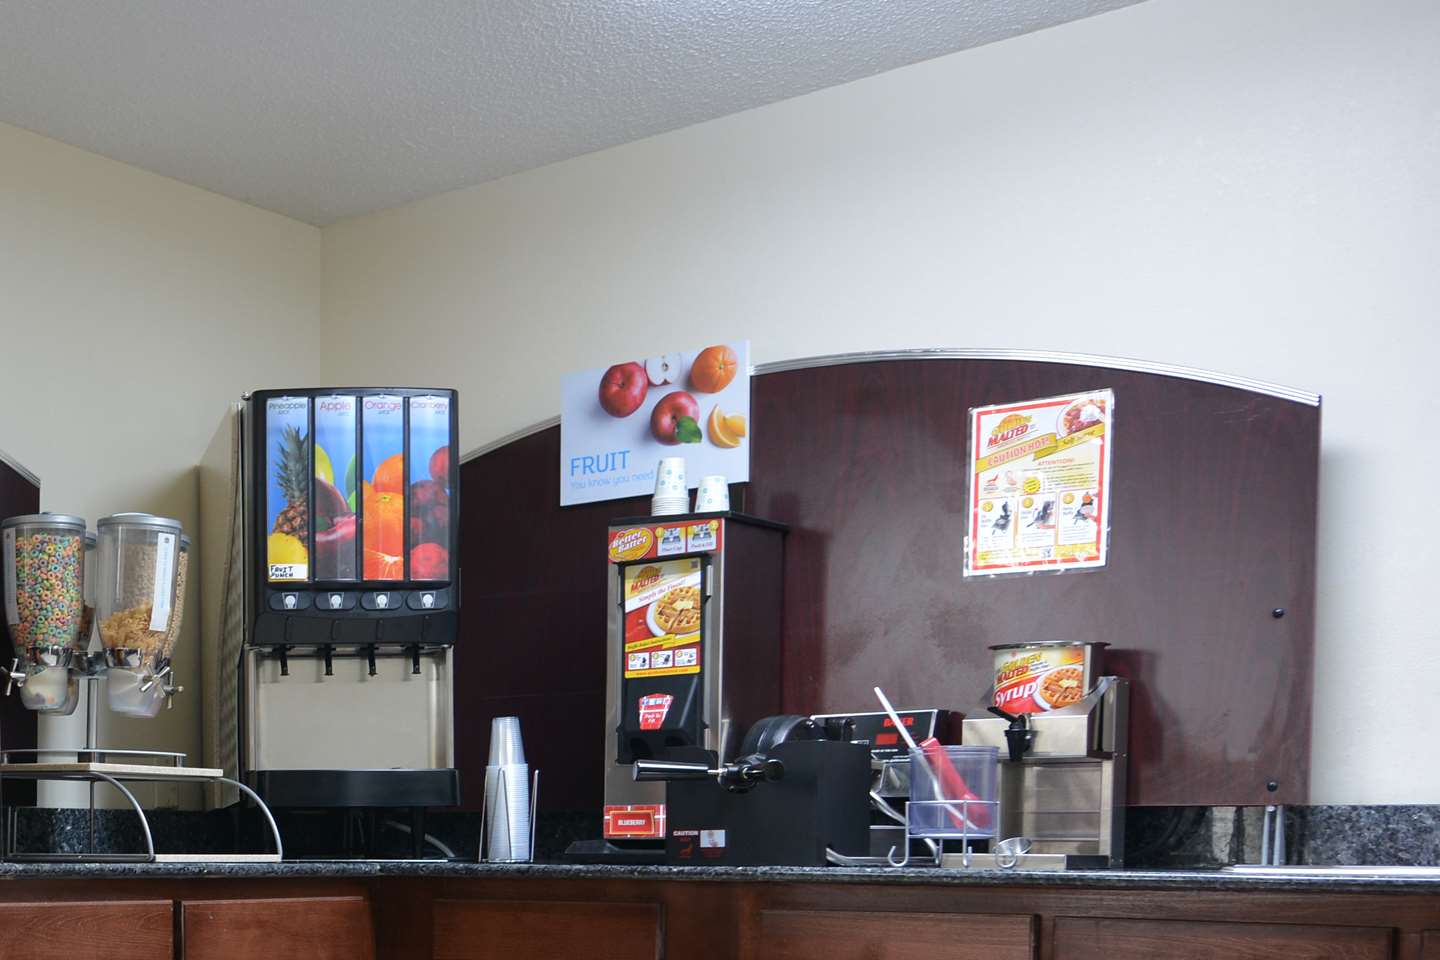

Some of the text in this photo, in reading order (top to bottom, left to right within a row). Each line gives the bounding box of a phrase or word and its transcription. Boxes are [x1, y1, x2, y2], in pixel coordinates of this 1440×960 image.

[320, 401, 352, 412] Apple
[364, 401, 402, 412] Orange
[570, 450, 630, 477] FRUIT
[270, 564, 294, 573] FRUIT
[995, 682, 1038, 707] Syrup
